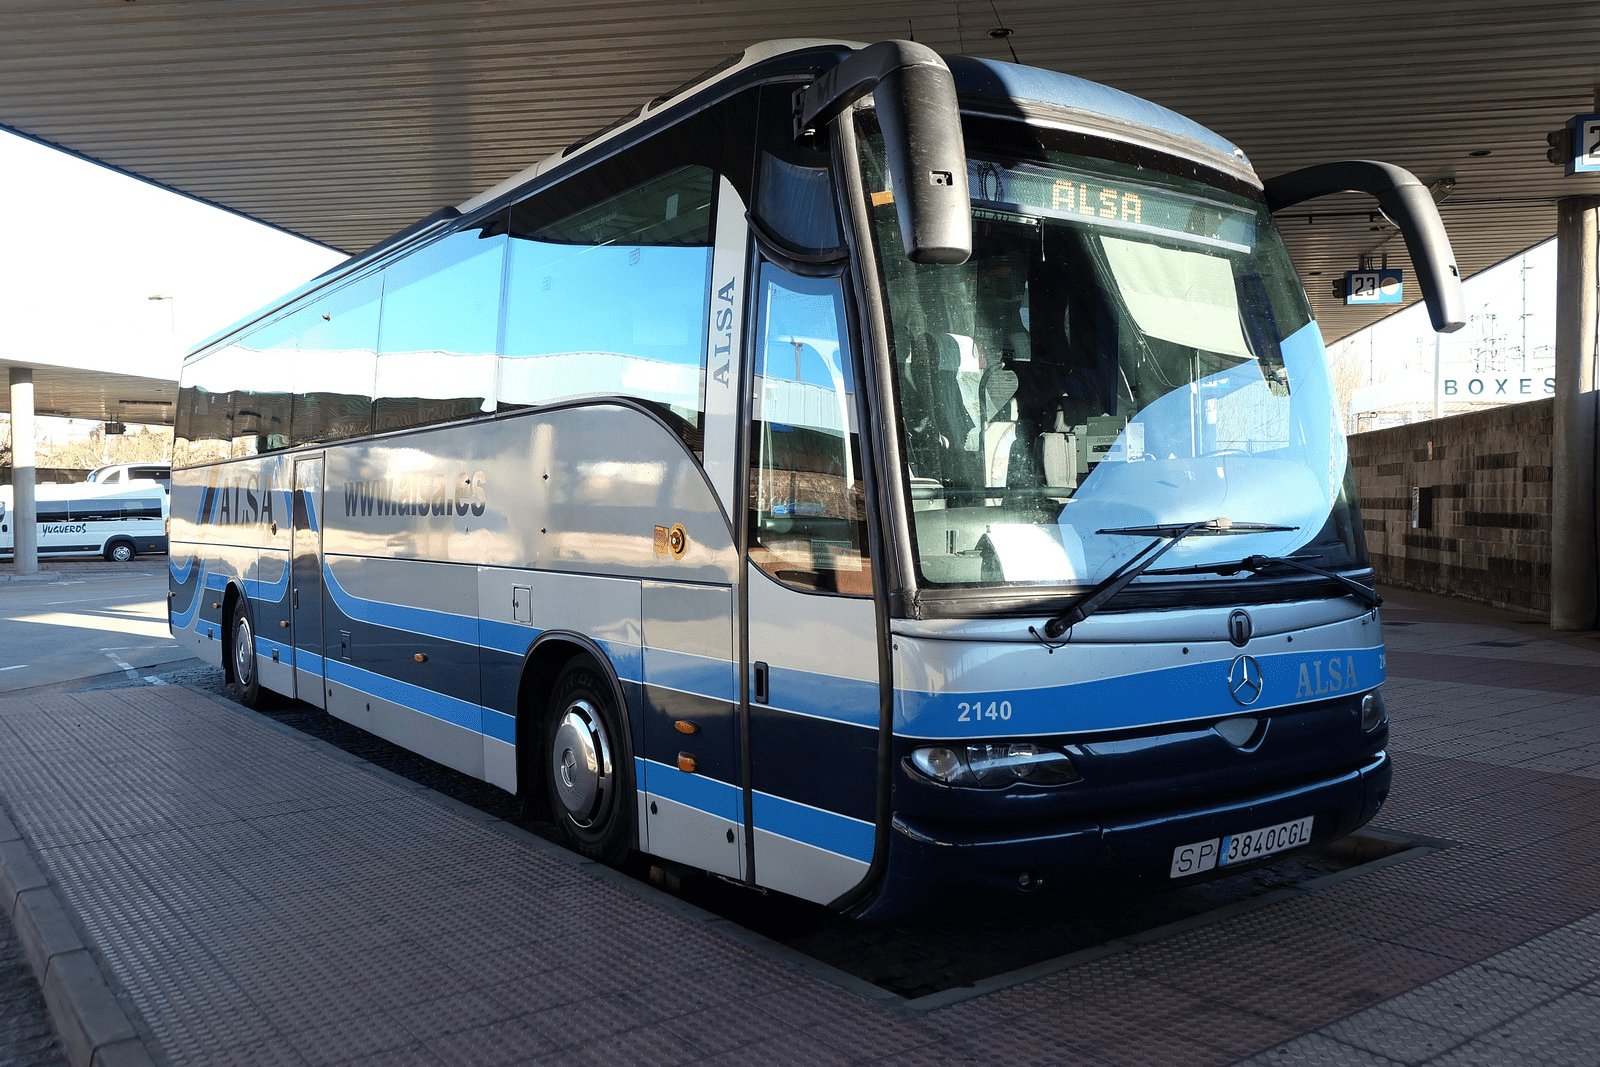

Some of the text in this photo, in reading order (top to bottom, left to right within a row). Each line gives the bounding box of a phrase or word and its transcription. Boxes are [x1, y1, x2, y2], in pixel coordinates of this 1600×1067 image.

[1053, 180, 1141, 223] ALSA
[1355, 276, 1376, 296] 23
[713, 276, 735, 389] ALSA
[1444, 377, 1556, 396] BOXES
[219, 473, 274, 527] ALSA
[42, 523, 87, 537] YUGUEROS
[1296, 655, 1359, 698] ALSA
[957, 700, 1012, 722] 2140
[1178, 821, 1308, 872] SP 3840CGL
